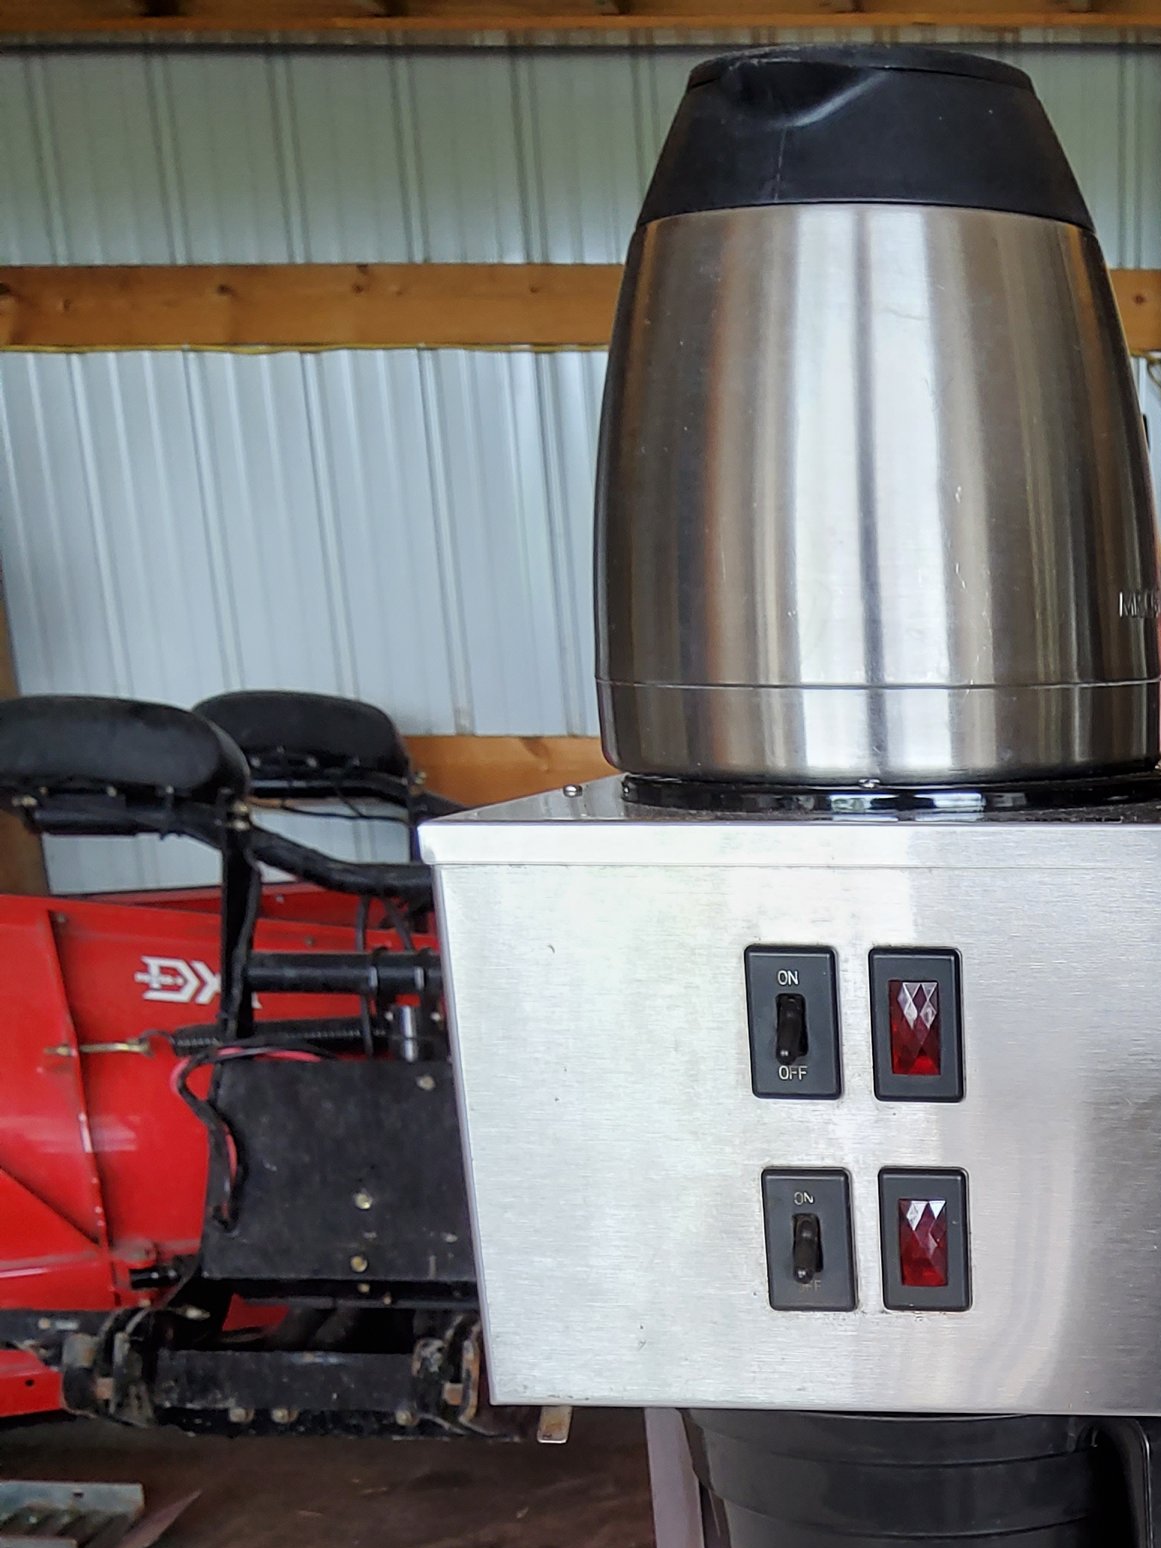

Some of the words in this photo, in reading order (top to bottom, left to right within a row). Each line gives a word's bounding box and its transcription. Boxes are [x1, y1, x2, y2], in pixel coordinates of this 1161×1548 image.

[777, 970, 799, 986] ON
[778, 1065, 807, 1081] OFF
[794, 1191, 814, 1206] ON
